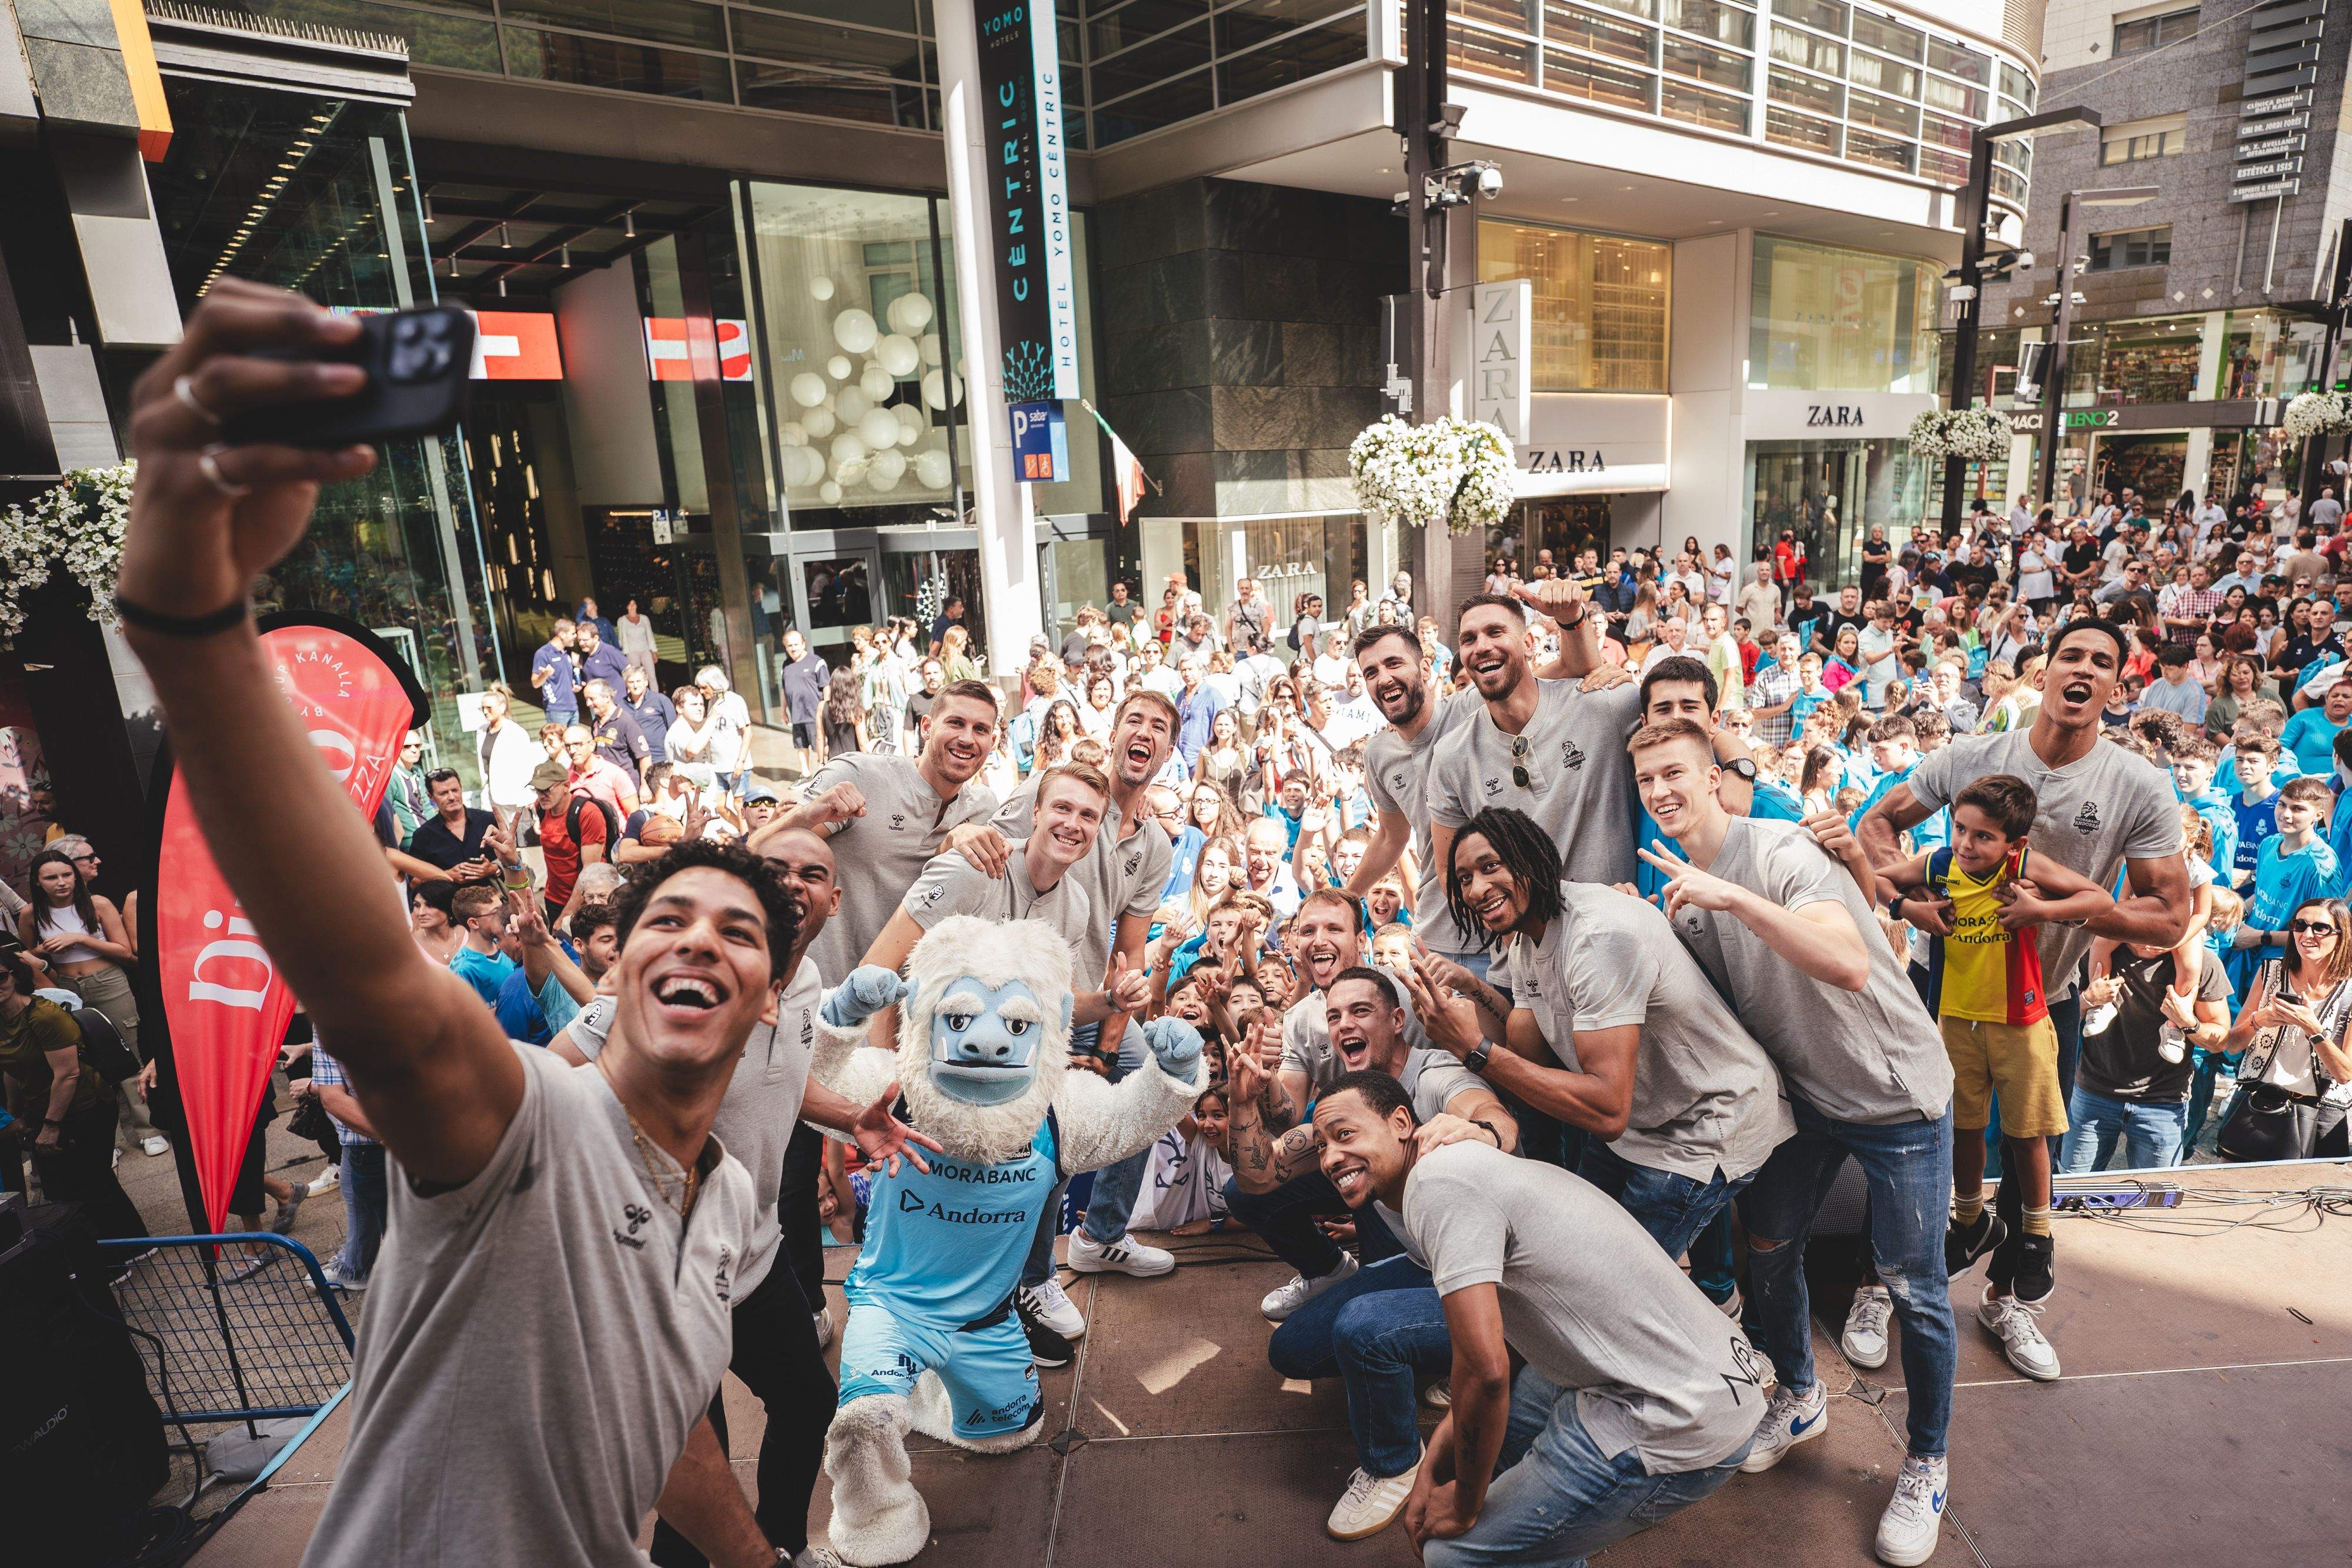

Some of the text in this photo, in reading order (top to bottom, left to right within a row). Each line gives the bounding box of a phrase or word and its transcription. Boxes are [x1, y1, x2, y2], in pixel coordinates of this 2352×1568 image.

[983, 6, 1023, 36] YOMO
[990, 31, 1019, 49] HOTELS
[2276, 94, 2304, 104] DENTAL
[2265, 121, 2283, 131] JORDI
[1022, 132, 1032, 192] HOTEL
[2237, 161, 2294, 179] ESTÉTICA ISIS
[999, 80, 1028, 301] CÈNTRIC
[1051, 193, 1064, 257] YOMO
[1057, 282, 1071, 367] HOTEL
[1479, 287, 1516, 438] ZARA
[1807, 405, 1864, 427] ZARA
[1013, 410, 1028, 449] P
[1528, 450, 1605, 474] ZARA
[1257, 560, 1318, 580] ZARA
[295, 650, 352, 698] KANALLA
[1486, 787, 1504, 798] hummel
[2074, 820, 2099, 830] ANDORRA
[1936, 875, 1960, 885] SPALDING
[929, 1159, 1037, 1184] MORABANC
[926, 1202, 1025, 1224] Andorra
[991, 1394, 1027, 1415] andorra
[991, 1402, 1030, 1422] telecom
